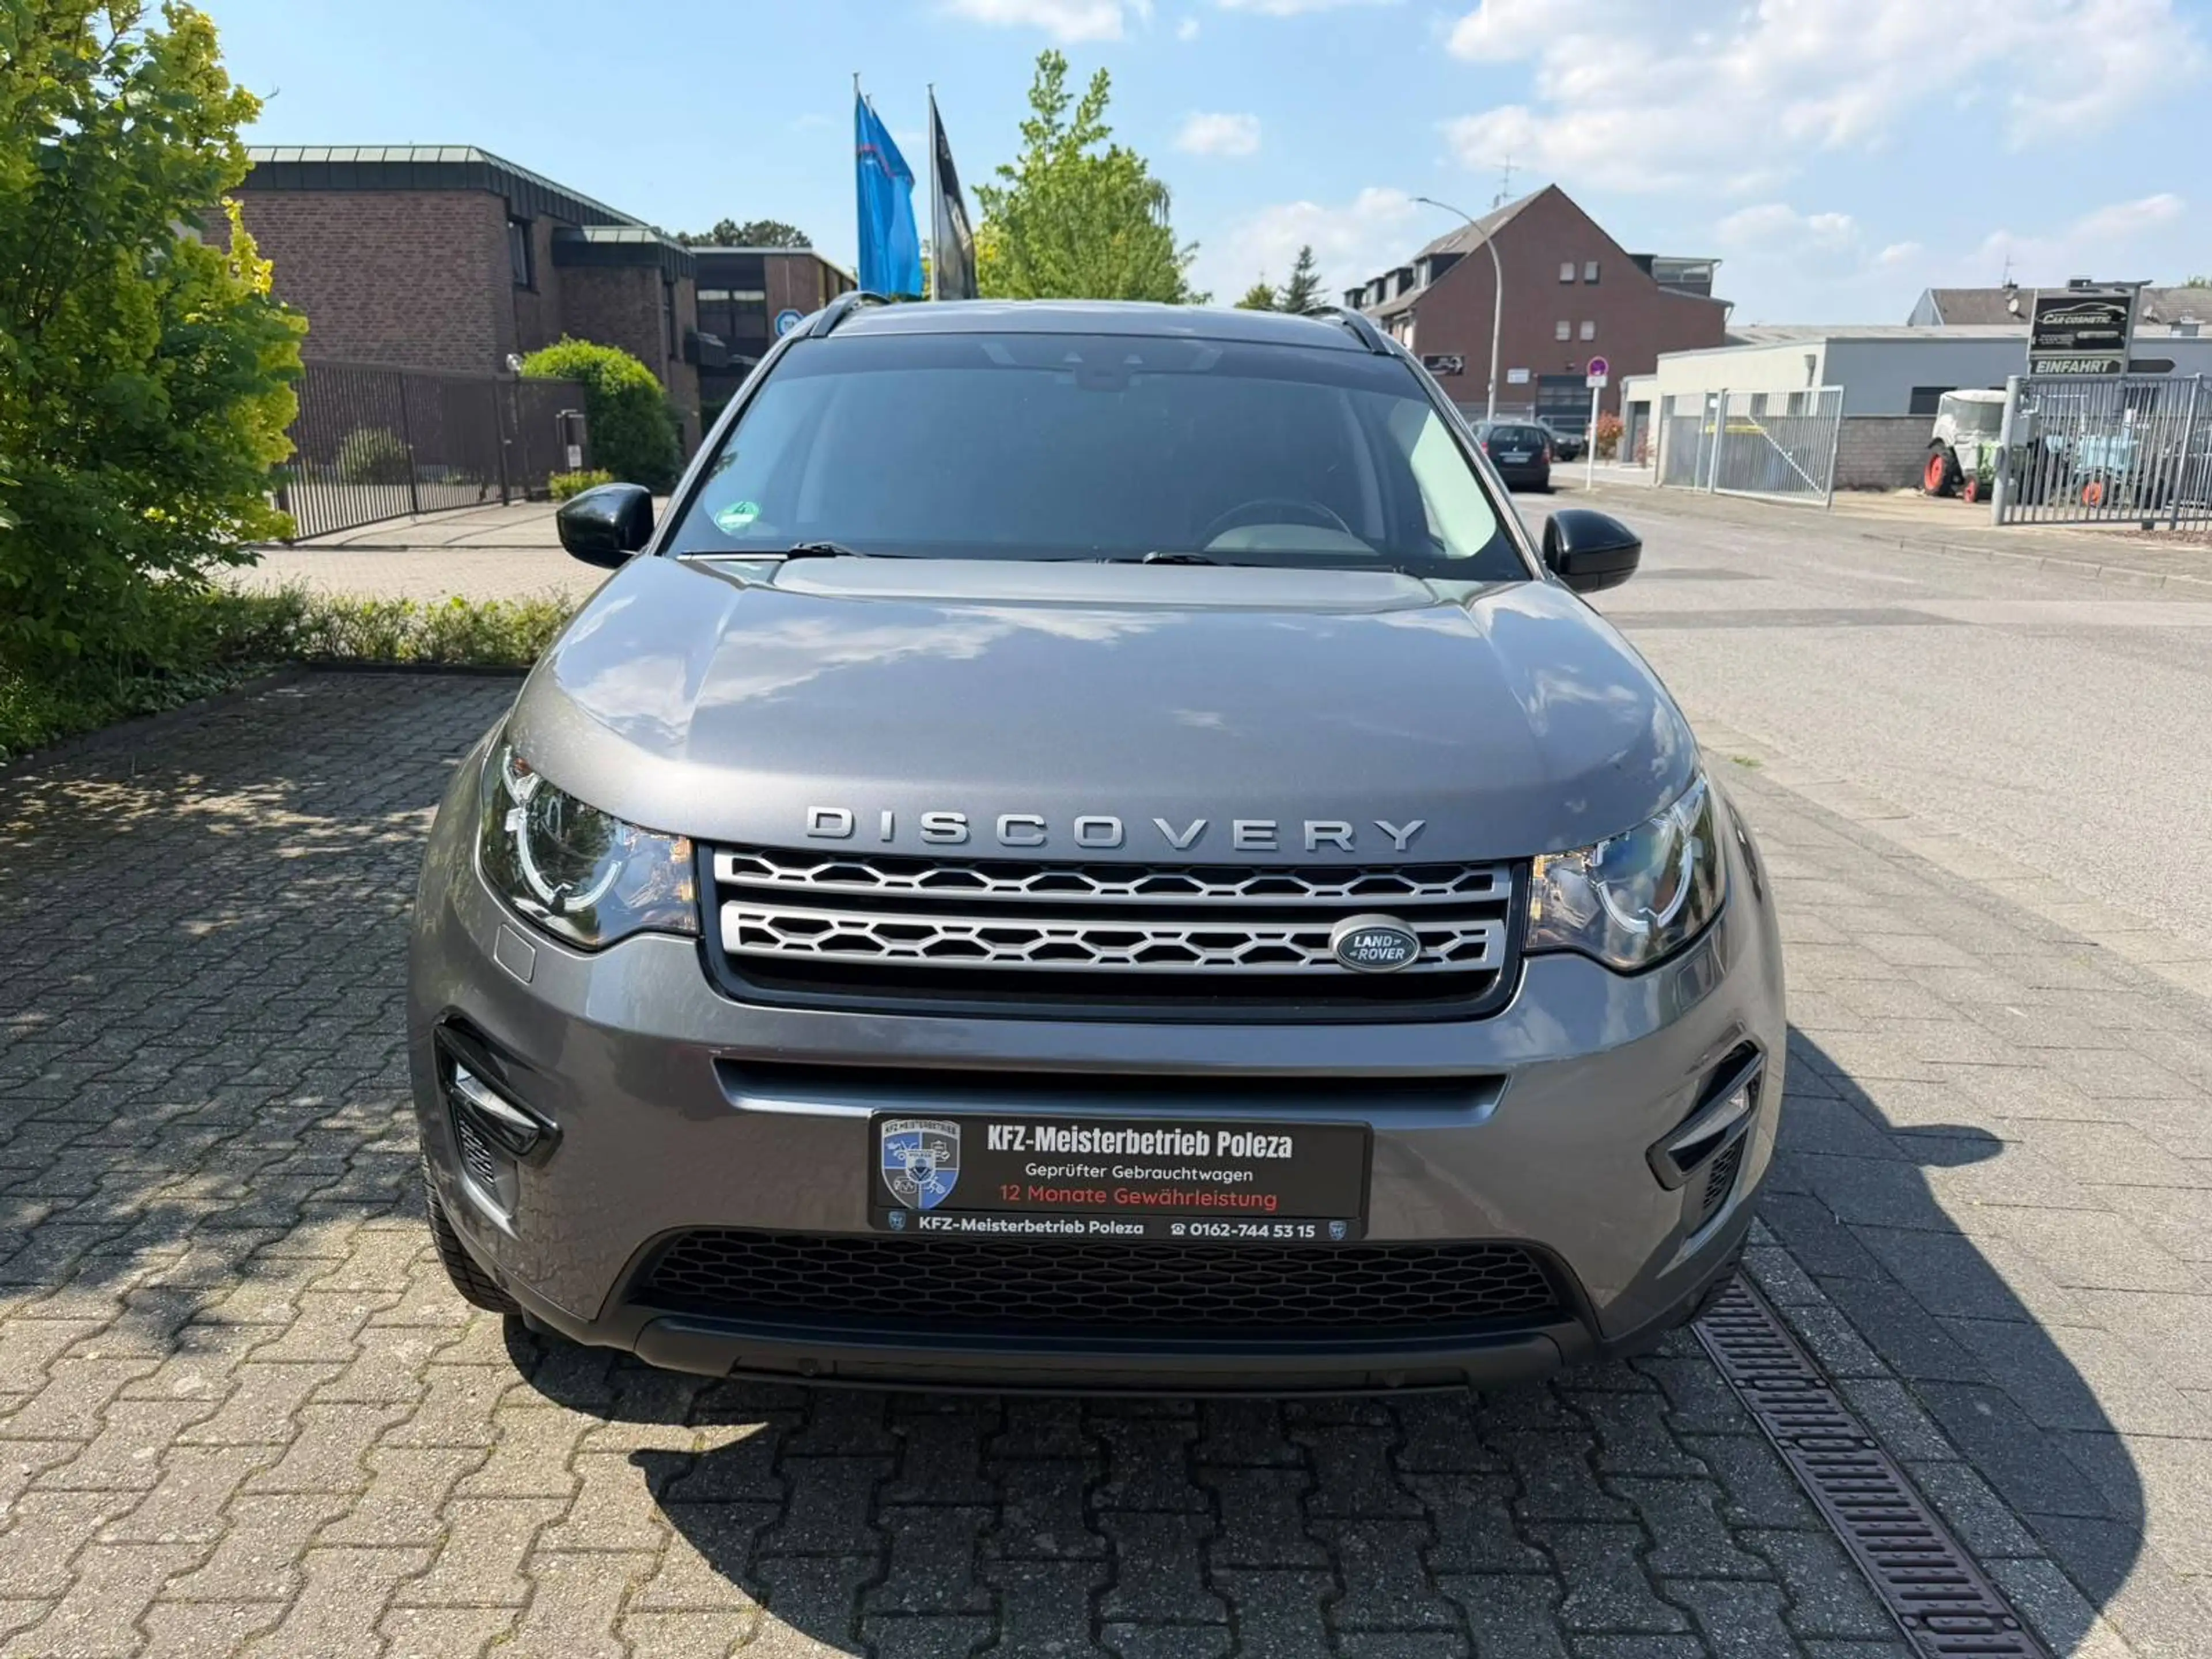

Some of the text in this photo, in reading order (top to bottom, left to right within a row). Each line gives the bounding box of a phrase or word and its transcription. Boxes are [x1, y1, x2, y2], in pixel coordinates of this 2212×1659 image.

[2036, 360, 2111, 373] EINFAHRT
[805, 805, 1426, 851] DISCOVERY
[1354, 935, 1392, 948] LAND
[1357, 948, 1405, 960] ROVER
[987, 1124, 1293, 1158] KFZ-Meisterbetrieb Poleza
[1025, 1162, 1253, 1184] Geprüfter Gebrauchtwagen
[999, 1184, 1278, 1211] 12 Monate Gewährleistung
[919, 1217, 1144, 1234] KFZ-Meisterbetrieb Poleza
[1190, 1222, 1316, 1238] 0162-744 53 15
